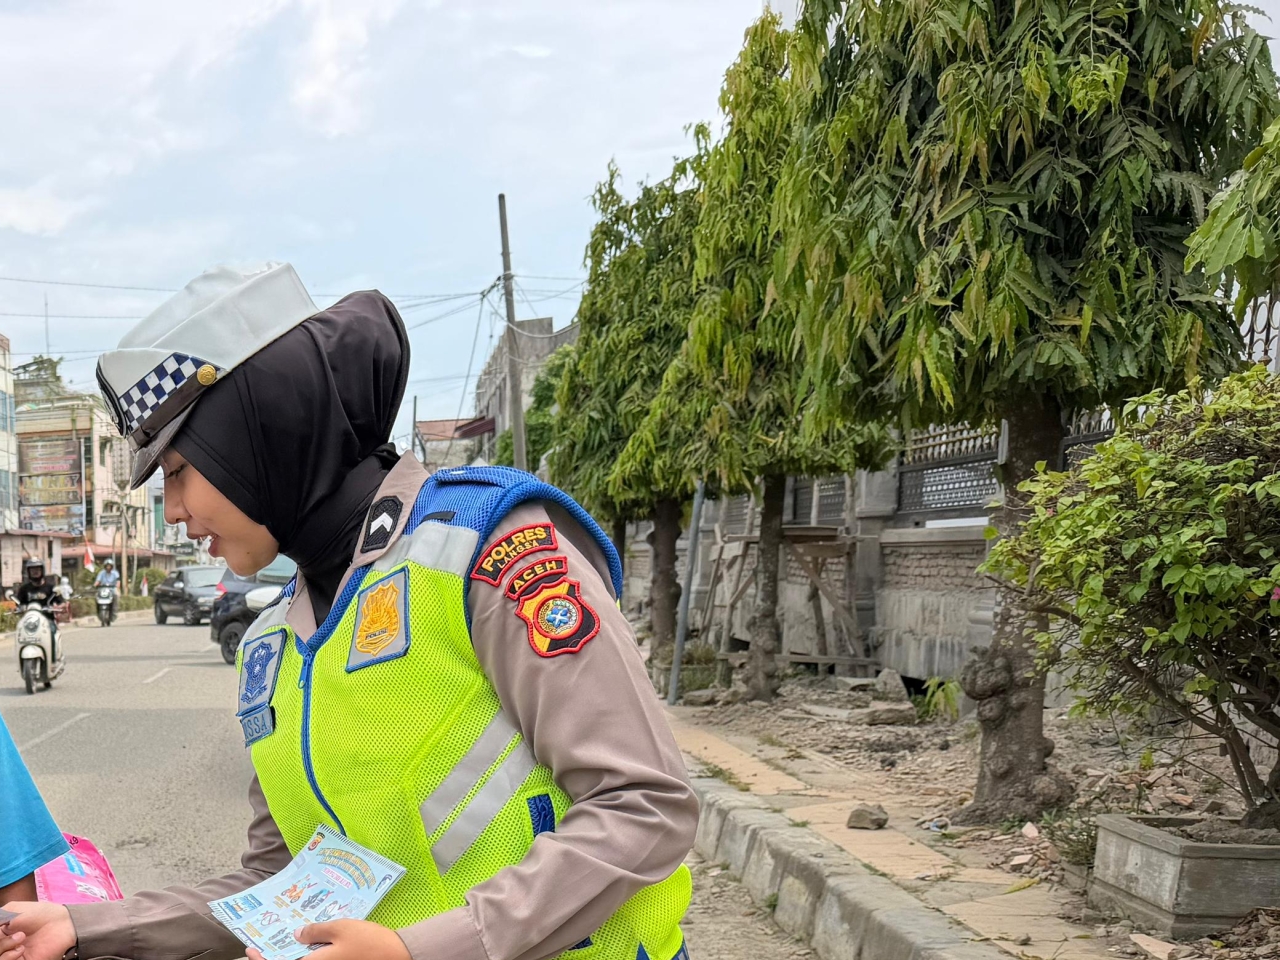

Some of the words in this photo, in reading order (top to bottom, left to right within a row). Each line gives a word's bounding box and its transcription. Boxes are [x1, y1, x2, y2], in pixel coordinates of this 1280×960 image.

[482, 527, 548, 572] POLRES
[497, 540, 539, 569] LANGSA
[513, 561, 557, 591] ACEH
